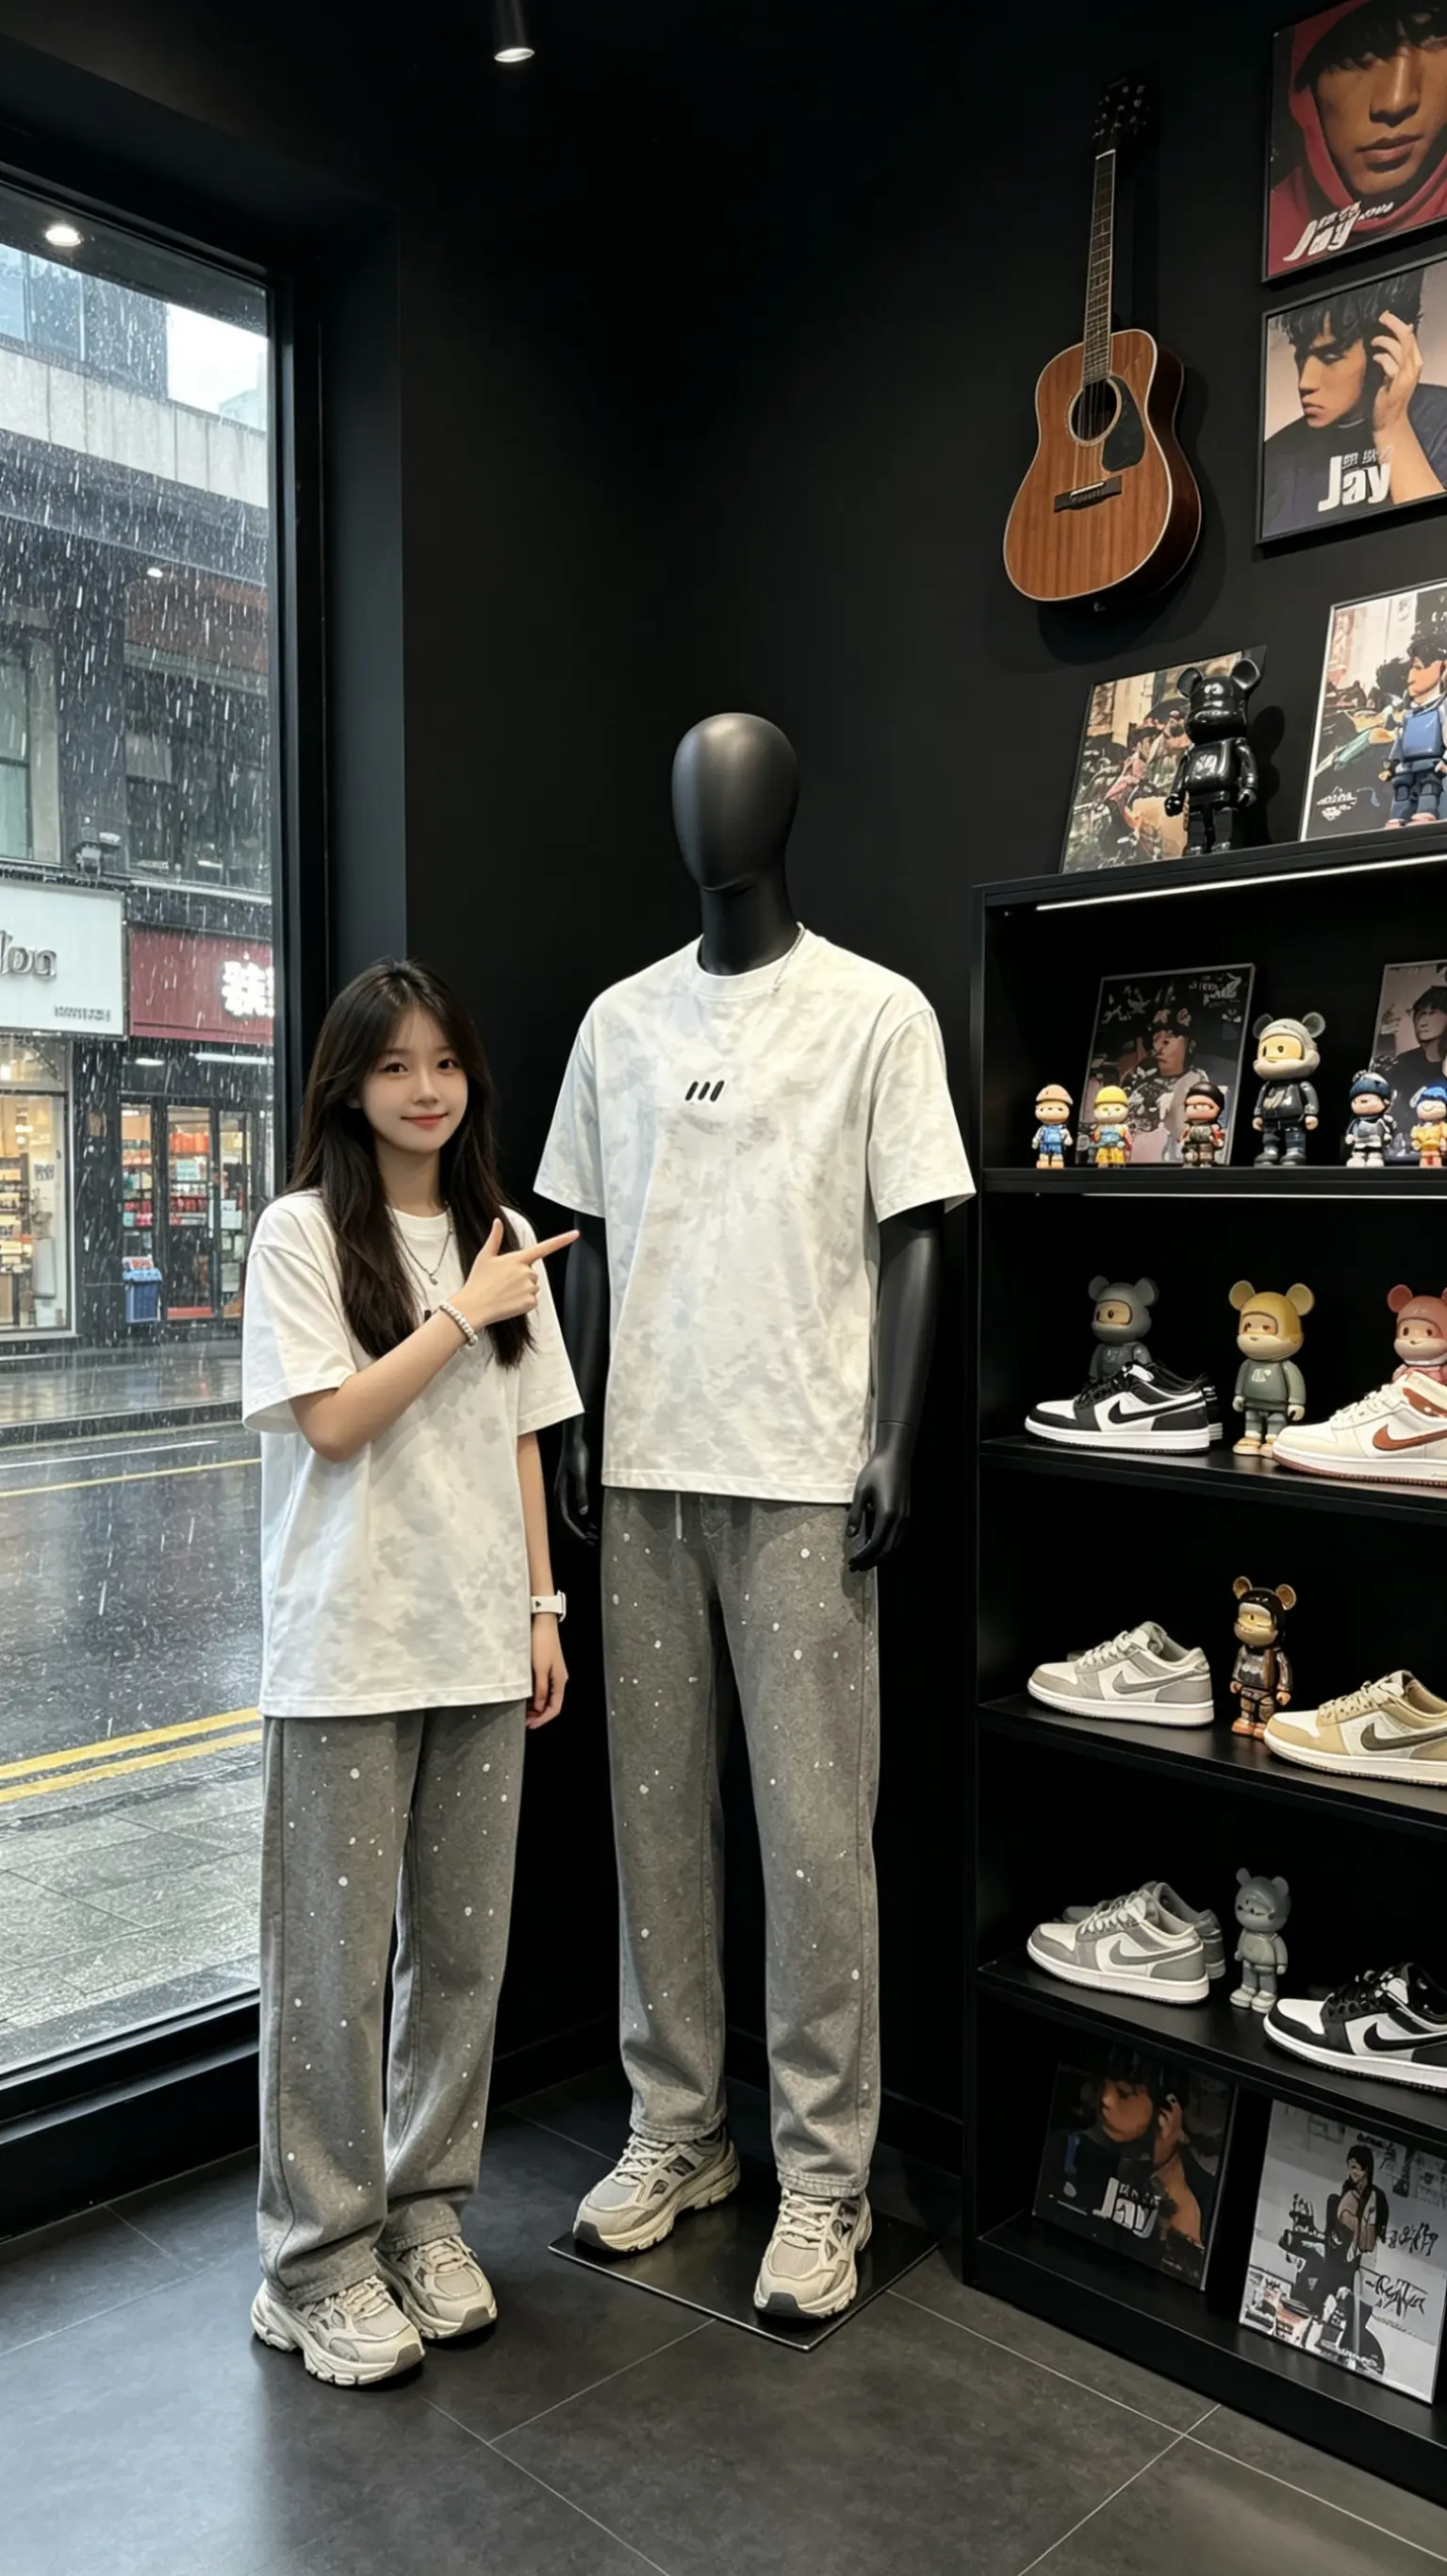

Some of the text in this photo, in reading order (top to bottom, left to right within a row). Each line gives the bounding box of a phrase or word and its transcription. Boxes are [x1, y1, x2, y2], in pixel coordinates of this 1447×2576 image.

[1283, 206, 1361, 261] Jay
[1317, 454, 1391, 512] Jay
[1093, 2176, 1158, 2238] Jay
